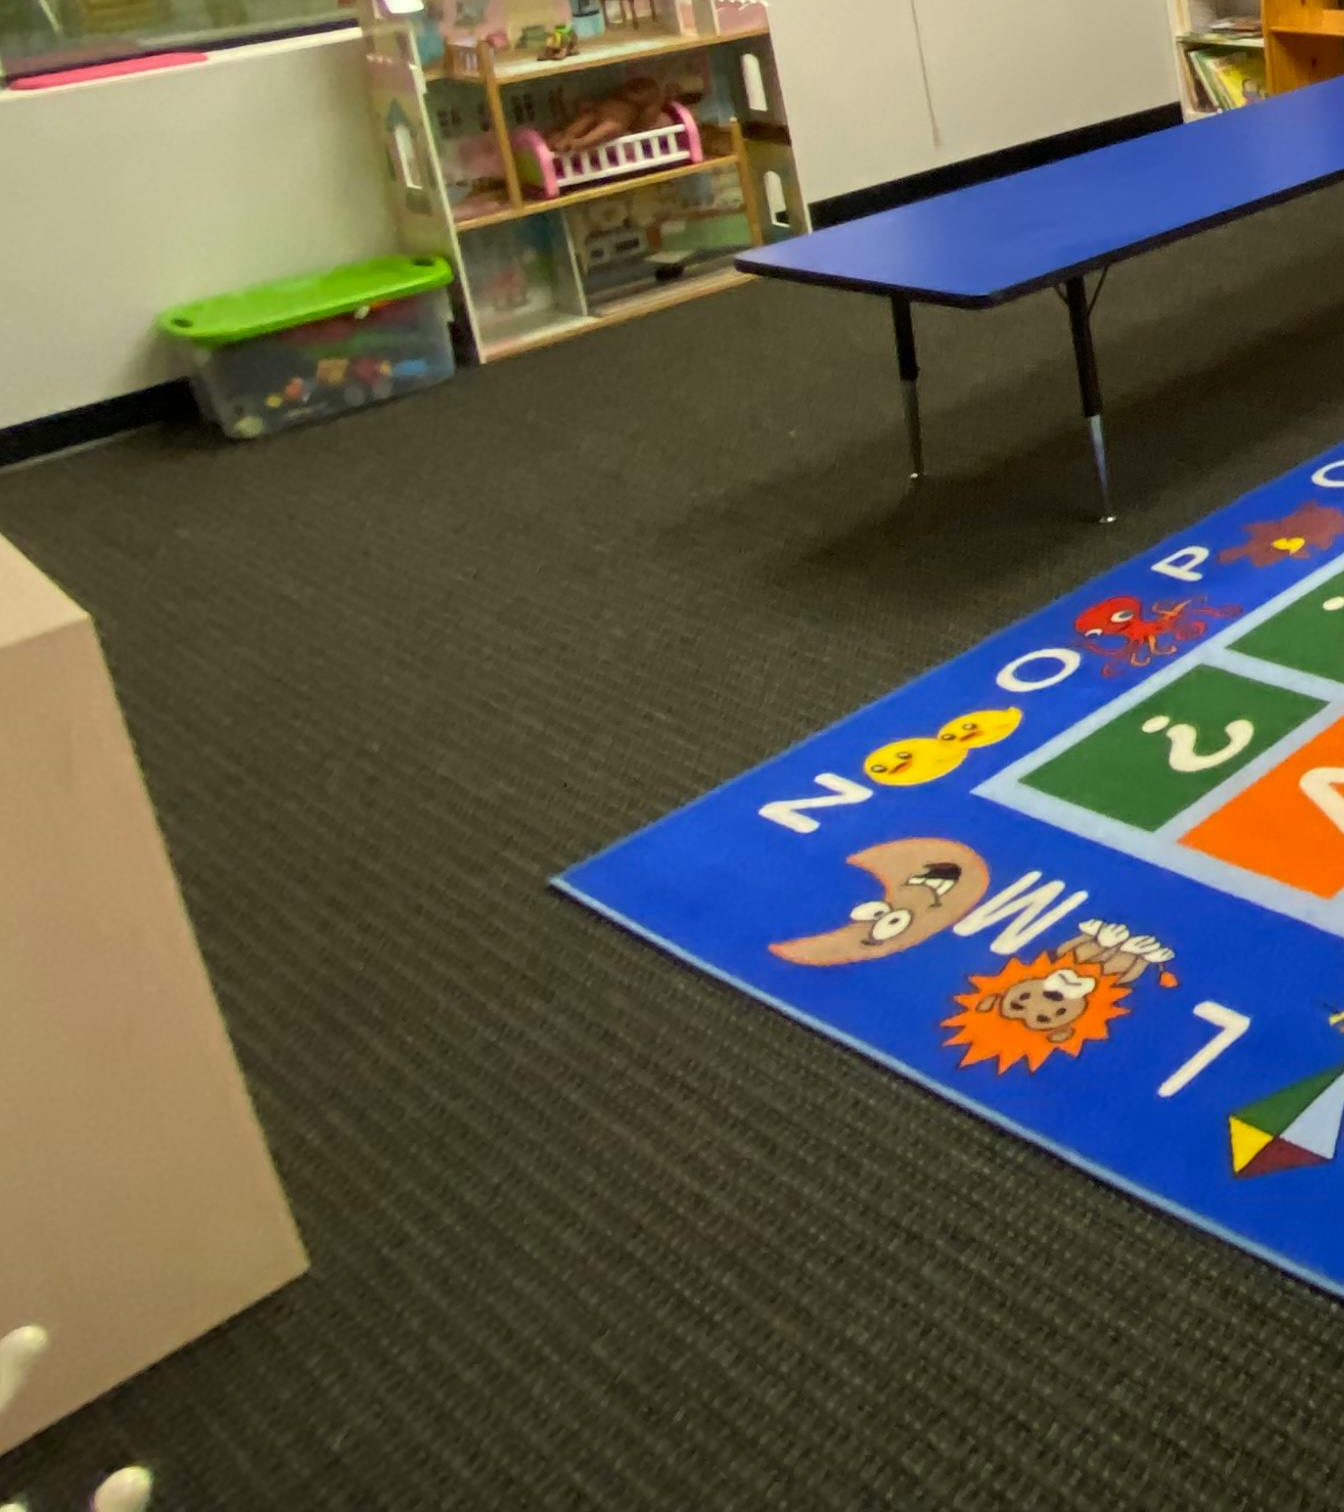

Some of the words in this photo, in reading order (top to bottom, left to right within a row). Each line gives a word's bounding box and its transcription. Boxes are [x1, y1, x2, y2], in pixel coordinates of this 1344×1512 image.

[761, 774, 871, 832] N
[996, 648, 1080, 692] O
[1150, 546, 1211, 582] P
[1142, 715, 1254, 772] ?
[954, 872, 1088, 955] M
[1158, 1002, 1250, 1096] L
